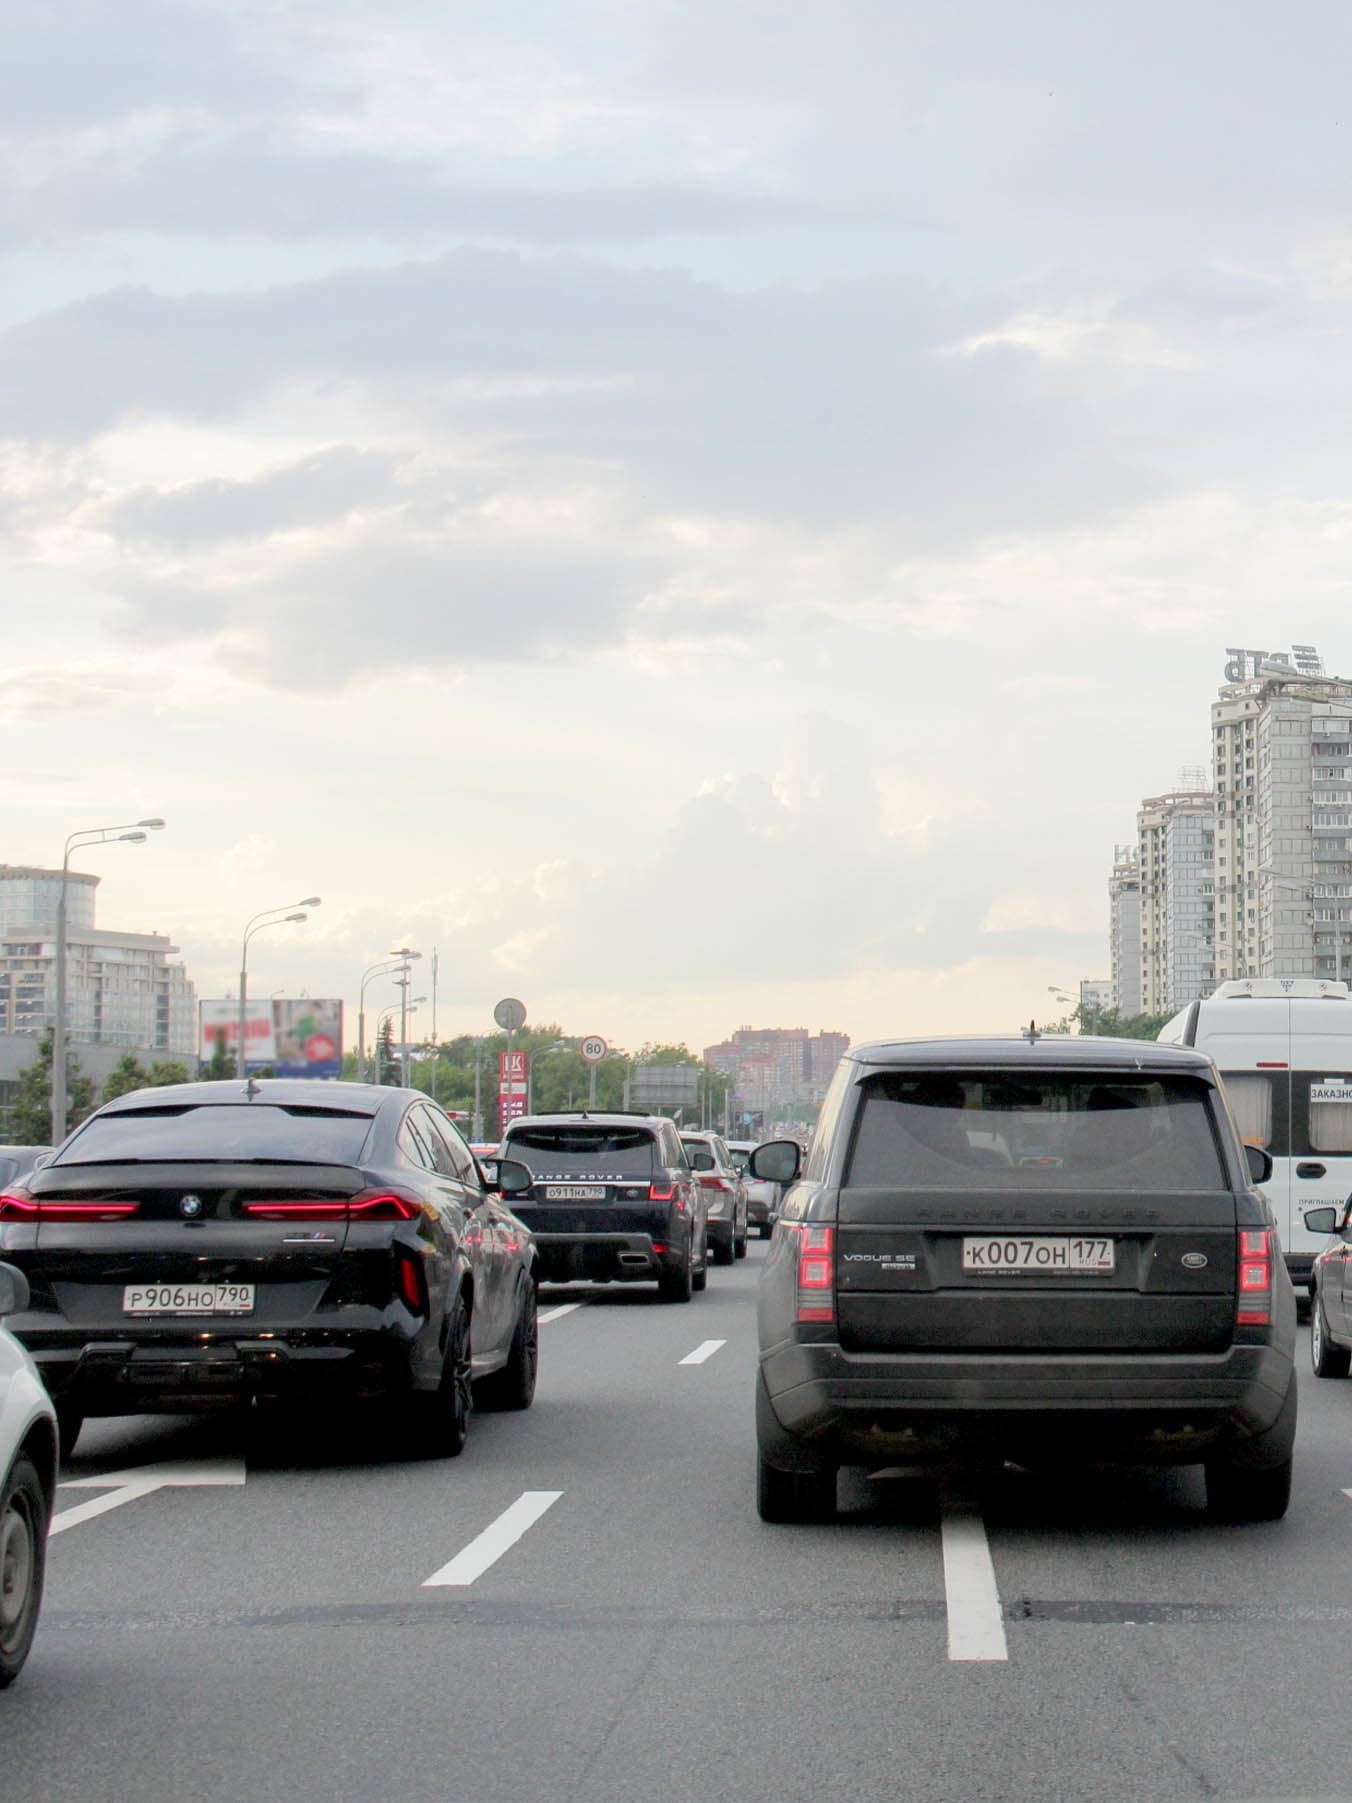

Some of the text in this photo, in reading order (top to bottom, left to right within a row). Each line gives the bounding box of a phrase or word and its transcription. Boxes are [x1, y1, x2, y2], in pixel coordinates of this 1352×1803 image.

[586, 1043, 602, 1055] 80
[843, 1254, 891, 1262] VOGUE
[971, 1240, 1108, 1265] К007ОН 177
[131, 1286, 249, 1308] Р906НО 790
